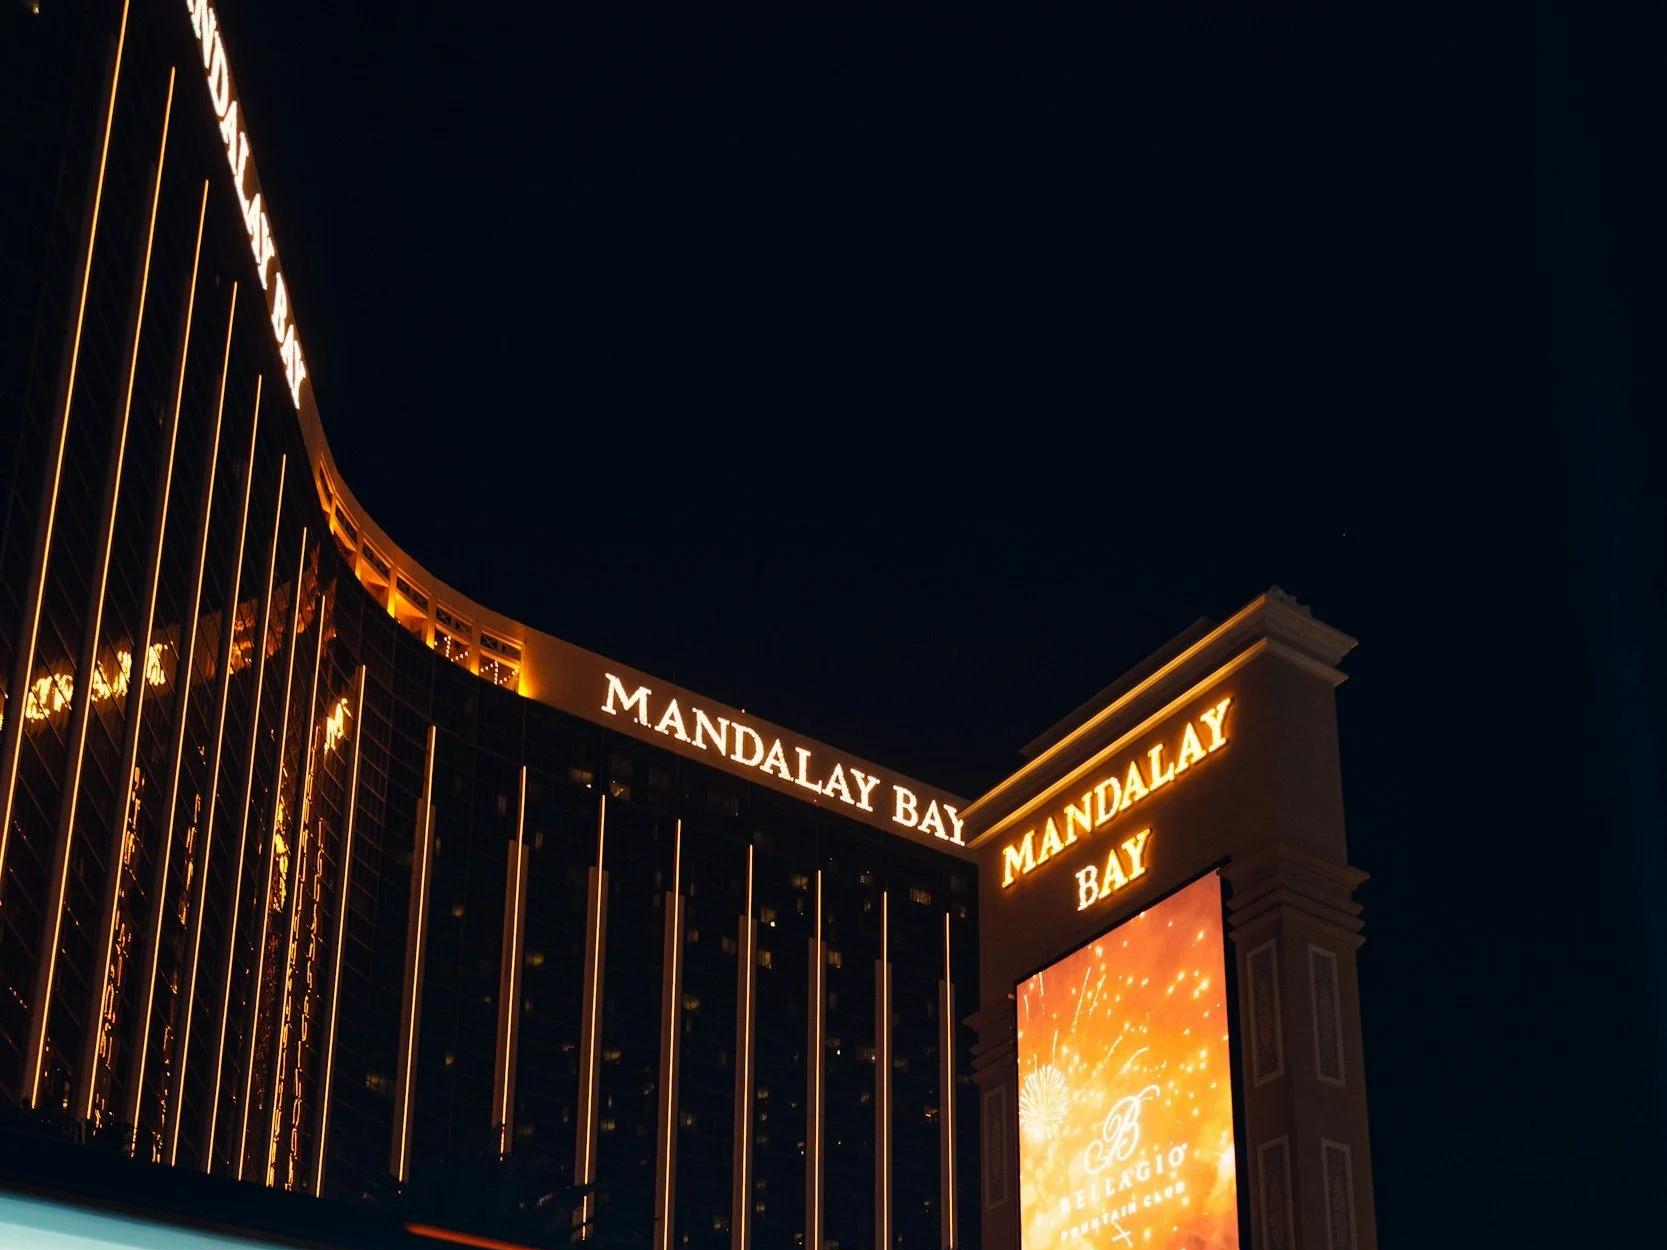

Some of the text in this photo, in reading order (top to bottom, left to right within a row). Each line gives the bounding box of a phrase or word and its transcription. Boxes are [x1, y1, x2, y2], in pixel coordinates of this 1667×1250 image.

[601, 672, 967, 847] MANDALAY BAY
[1001, 697, 1232, 889] MANDALAY
[1075, 828, 1152, 912] BAY
[1059, 1145, 1185, 1216] BELLAGIO
